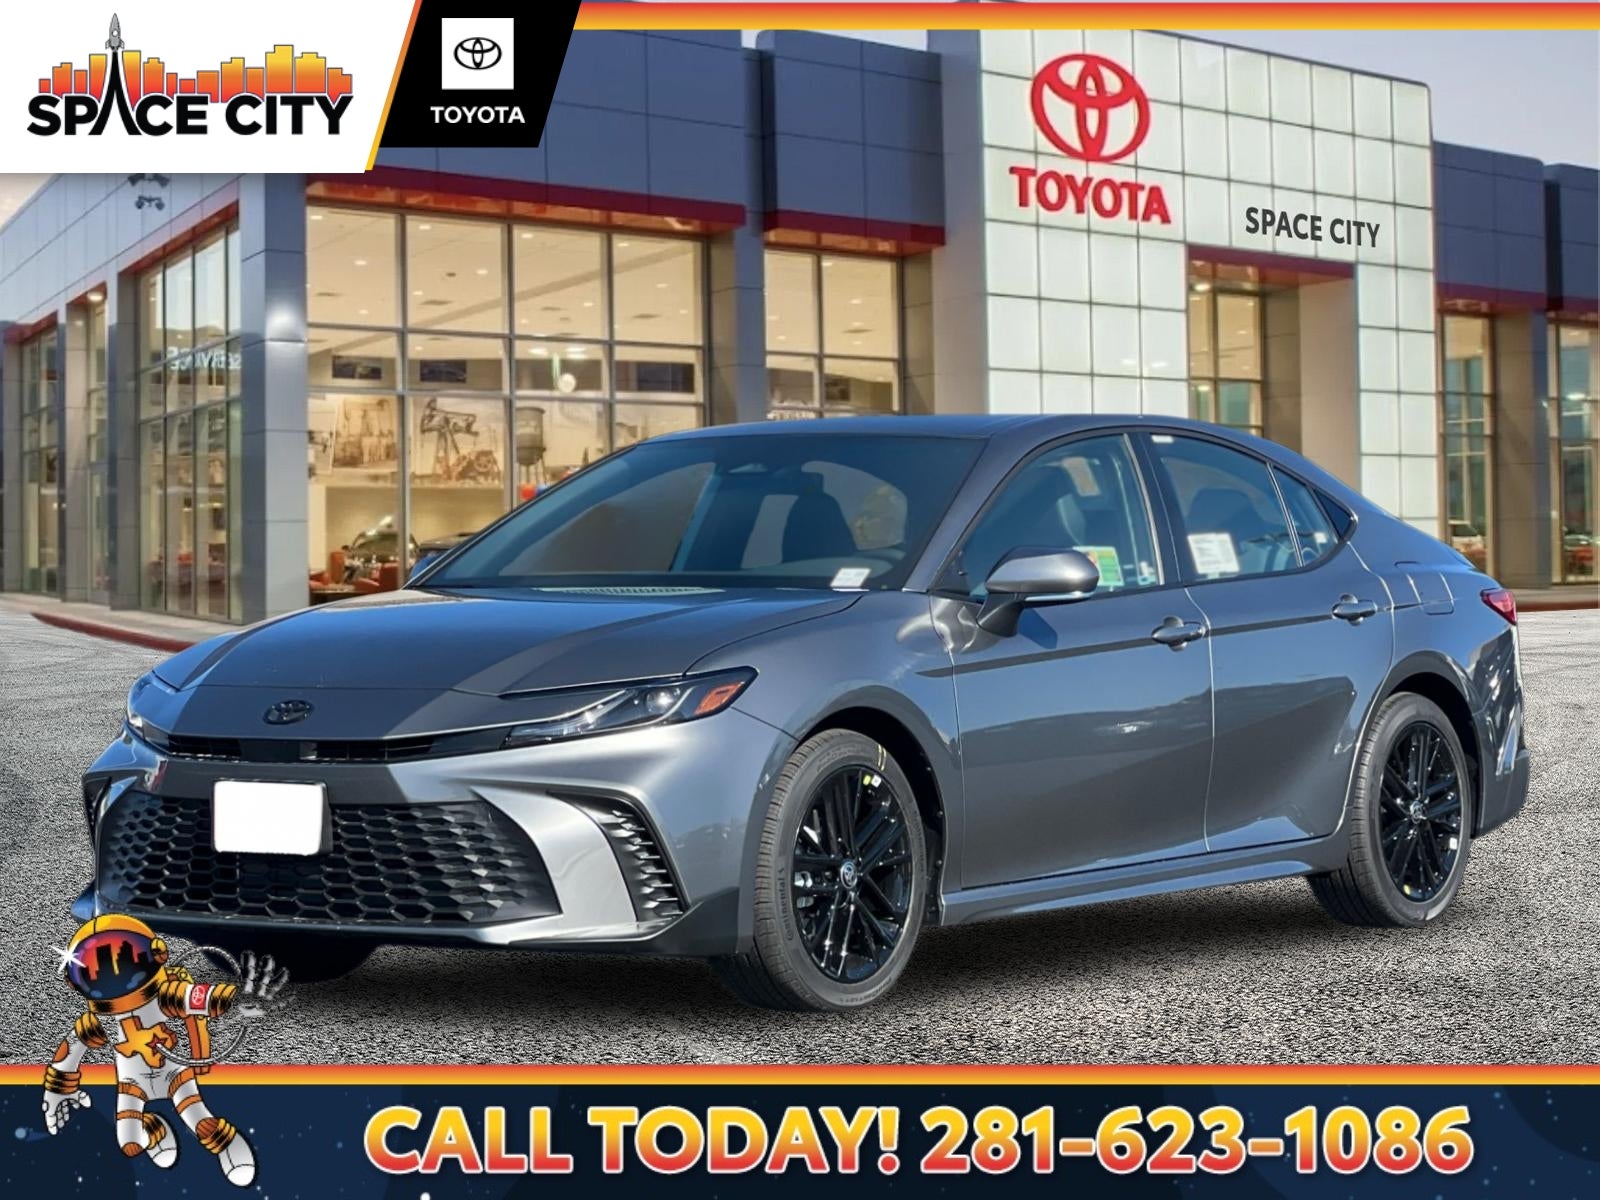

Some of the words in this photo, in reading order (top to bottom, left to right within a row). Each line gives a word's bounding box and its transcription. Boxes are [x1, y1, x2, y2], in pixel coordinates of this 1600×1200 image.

[1009, 165, 1171, 224] TOYOTA
[1245, 206, 1323, 242] SPACE
[1329, 217, 1380, 248] CITY
